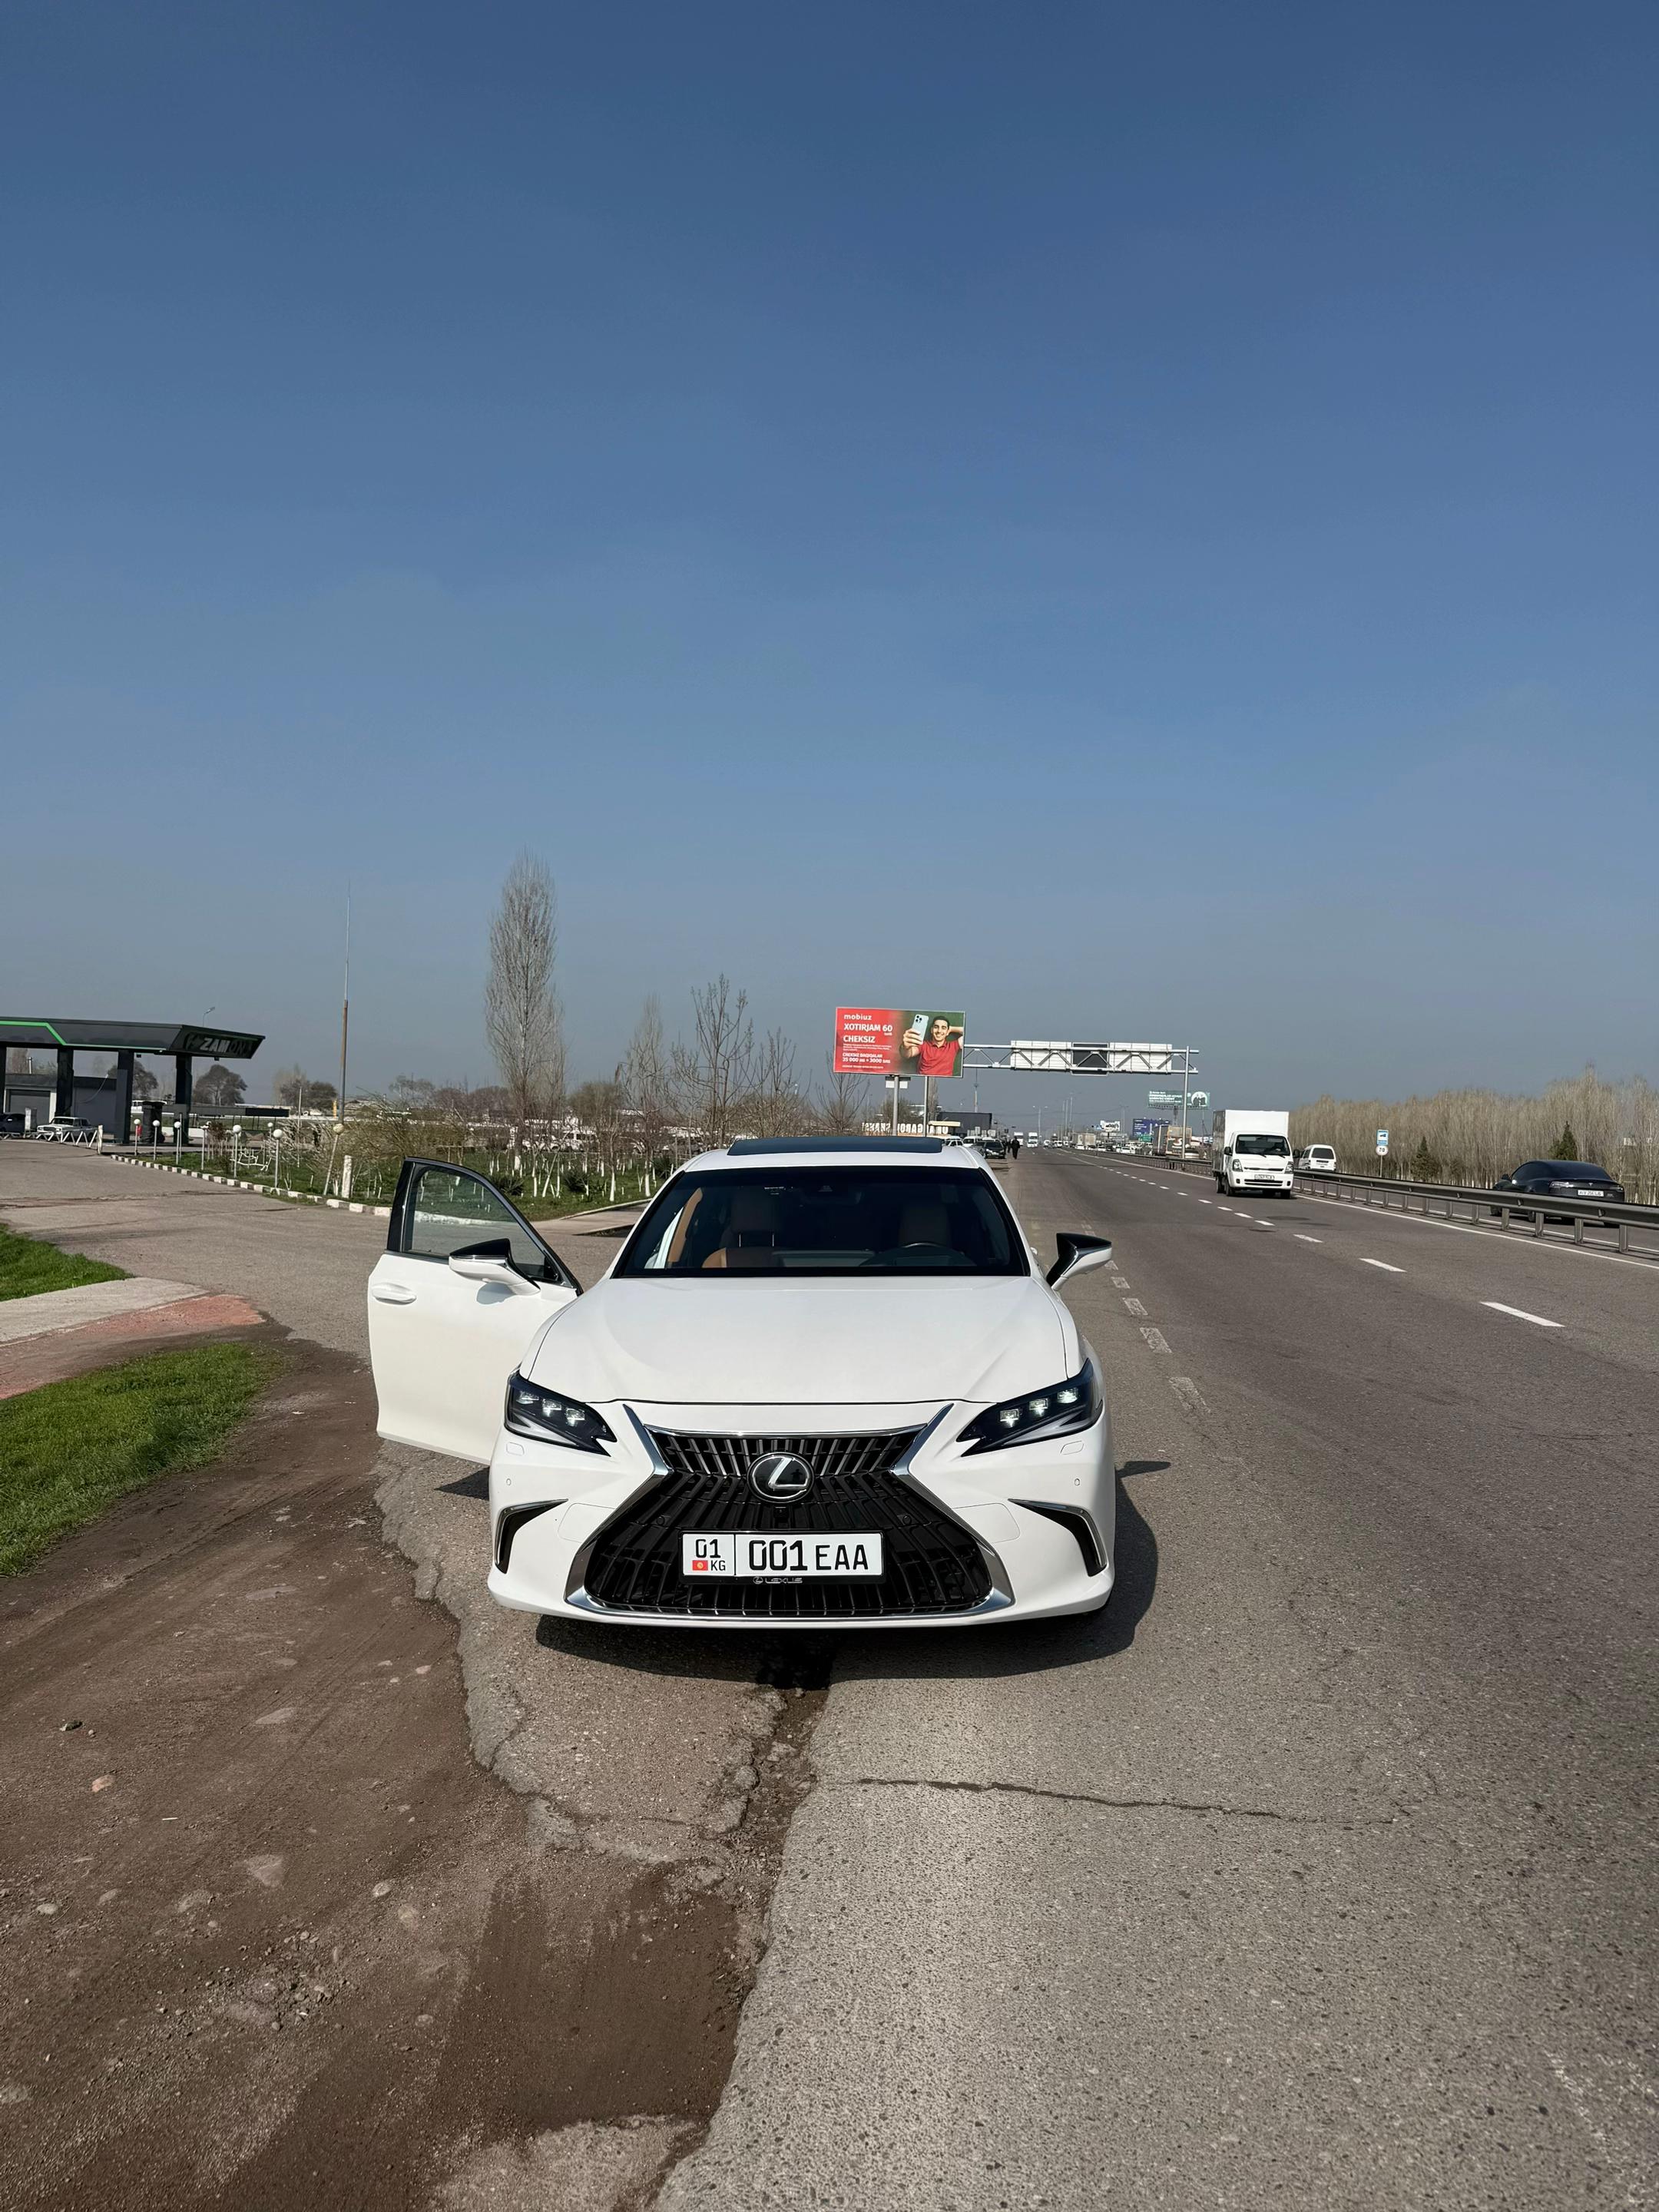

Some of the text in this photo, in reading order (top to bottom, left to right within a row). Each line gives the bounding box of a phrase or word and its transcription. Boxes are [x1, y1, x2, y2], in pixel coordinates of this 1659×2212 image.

[844, 1023, 881, 1032] XOTIRJAM
[695, 1538, 721, 1558] 01
[748, 1539, 869, 1571] 001 EAA
[710, 1560, 726, 1571] KG
